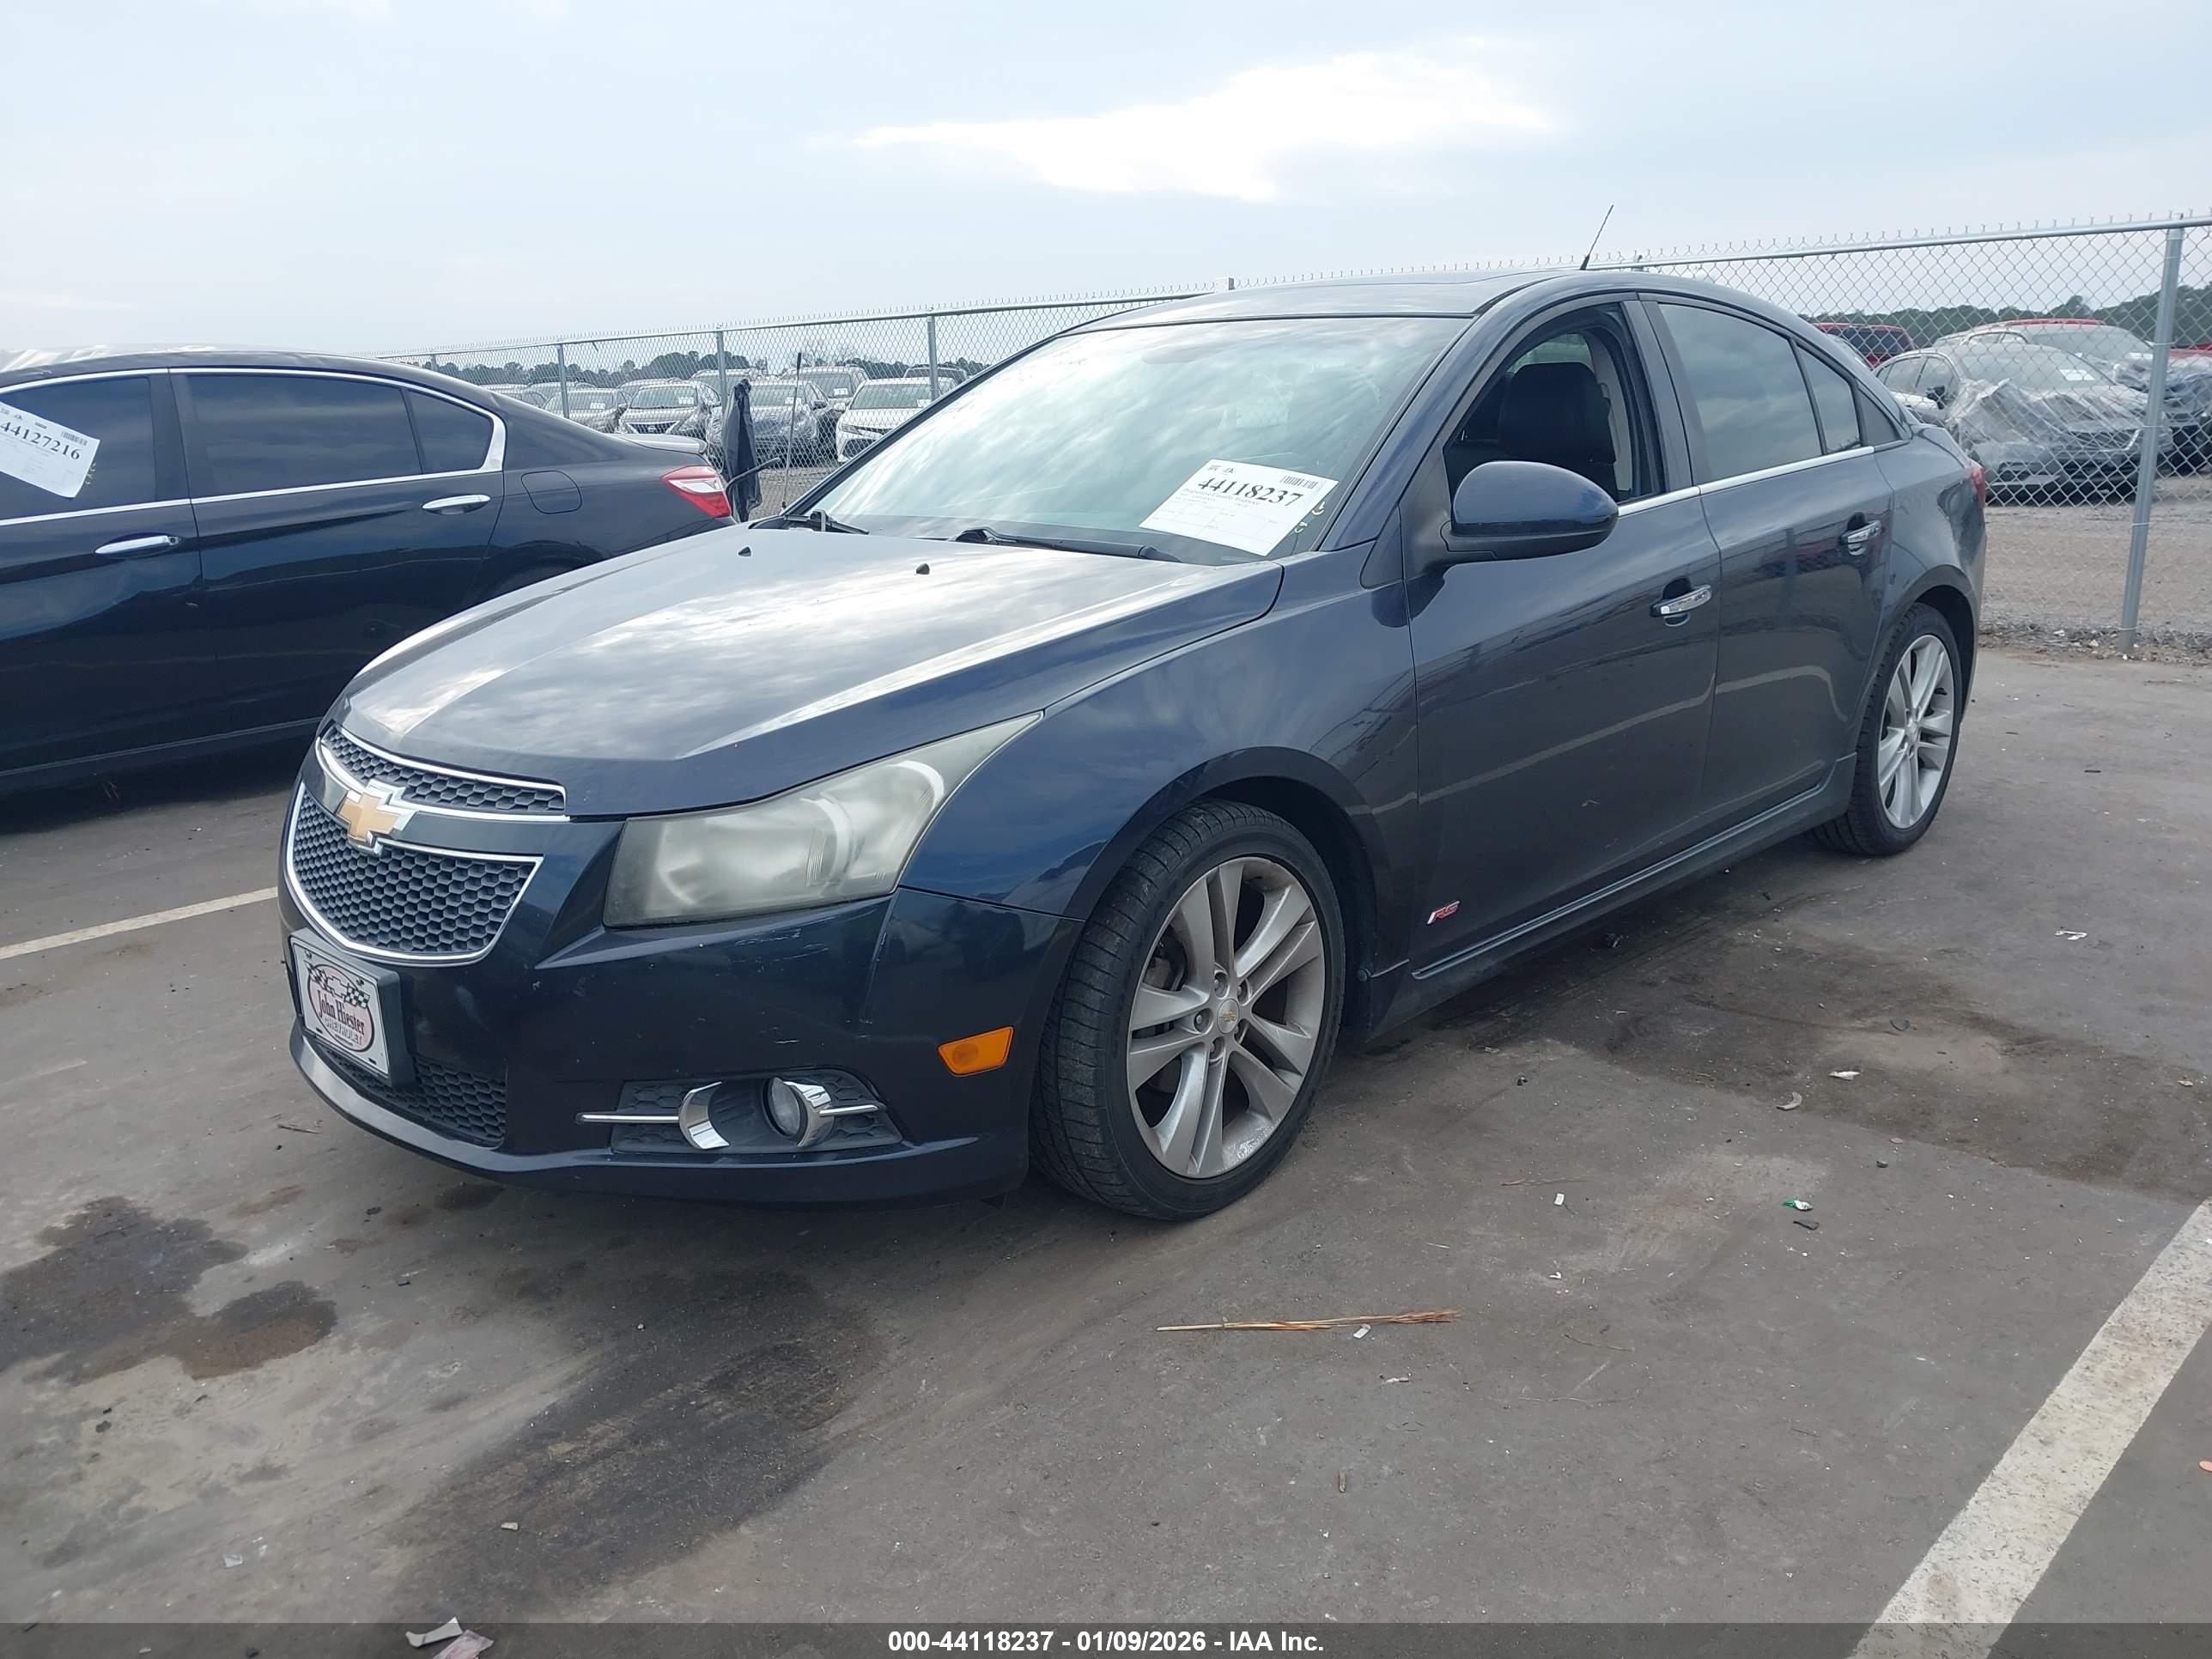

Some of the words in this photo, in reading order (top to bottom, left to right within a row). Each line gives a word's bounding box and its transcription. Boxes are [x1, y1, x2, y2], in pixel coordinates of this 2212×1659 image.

[0, 422, 82, 460] 44127216
[1198, 477, 1304, 507] 44118237
[317, 989, 337, 1019] John
[336, 999, 364, 1036] Hiester
[324, 1016, 362, 1046] CHEVROLET
